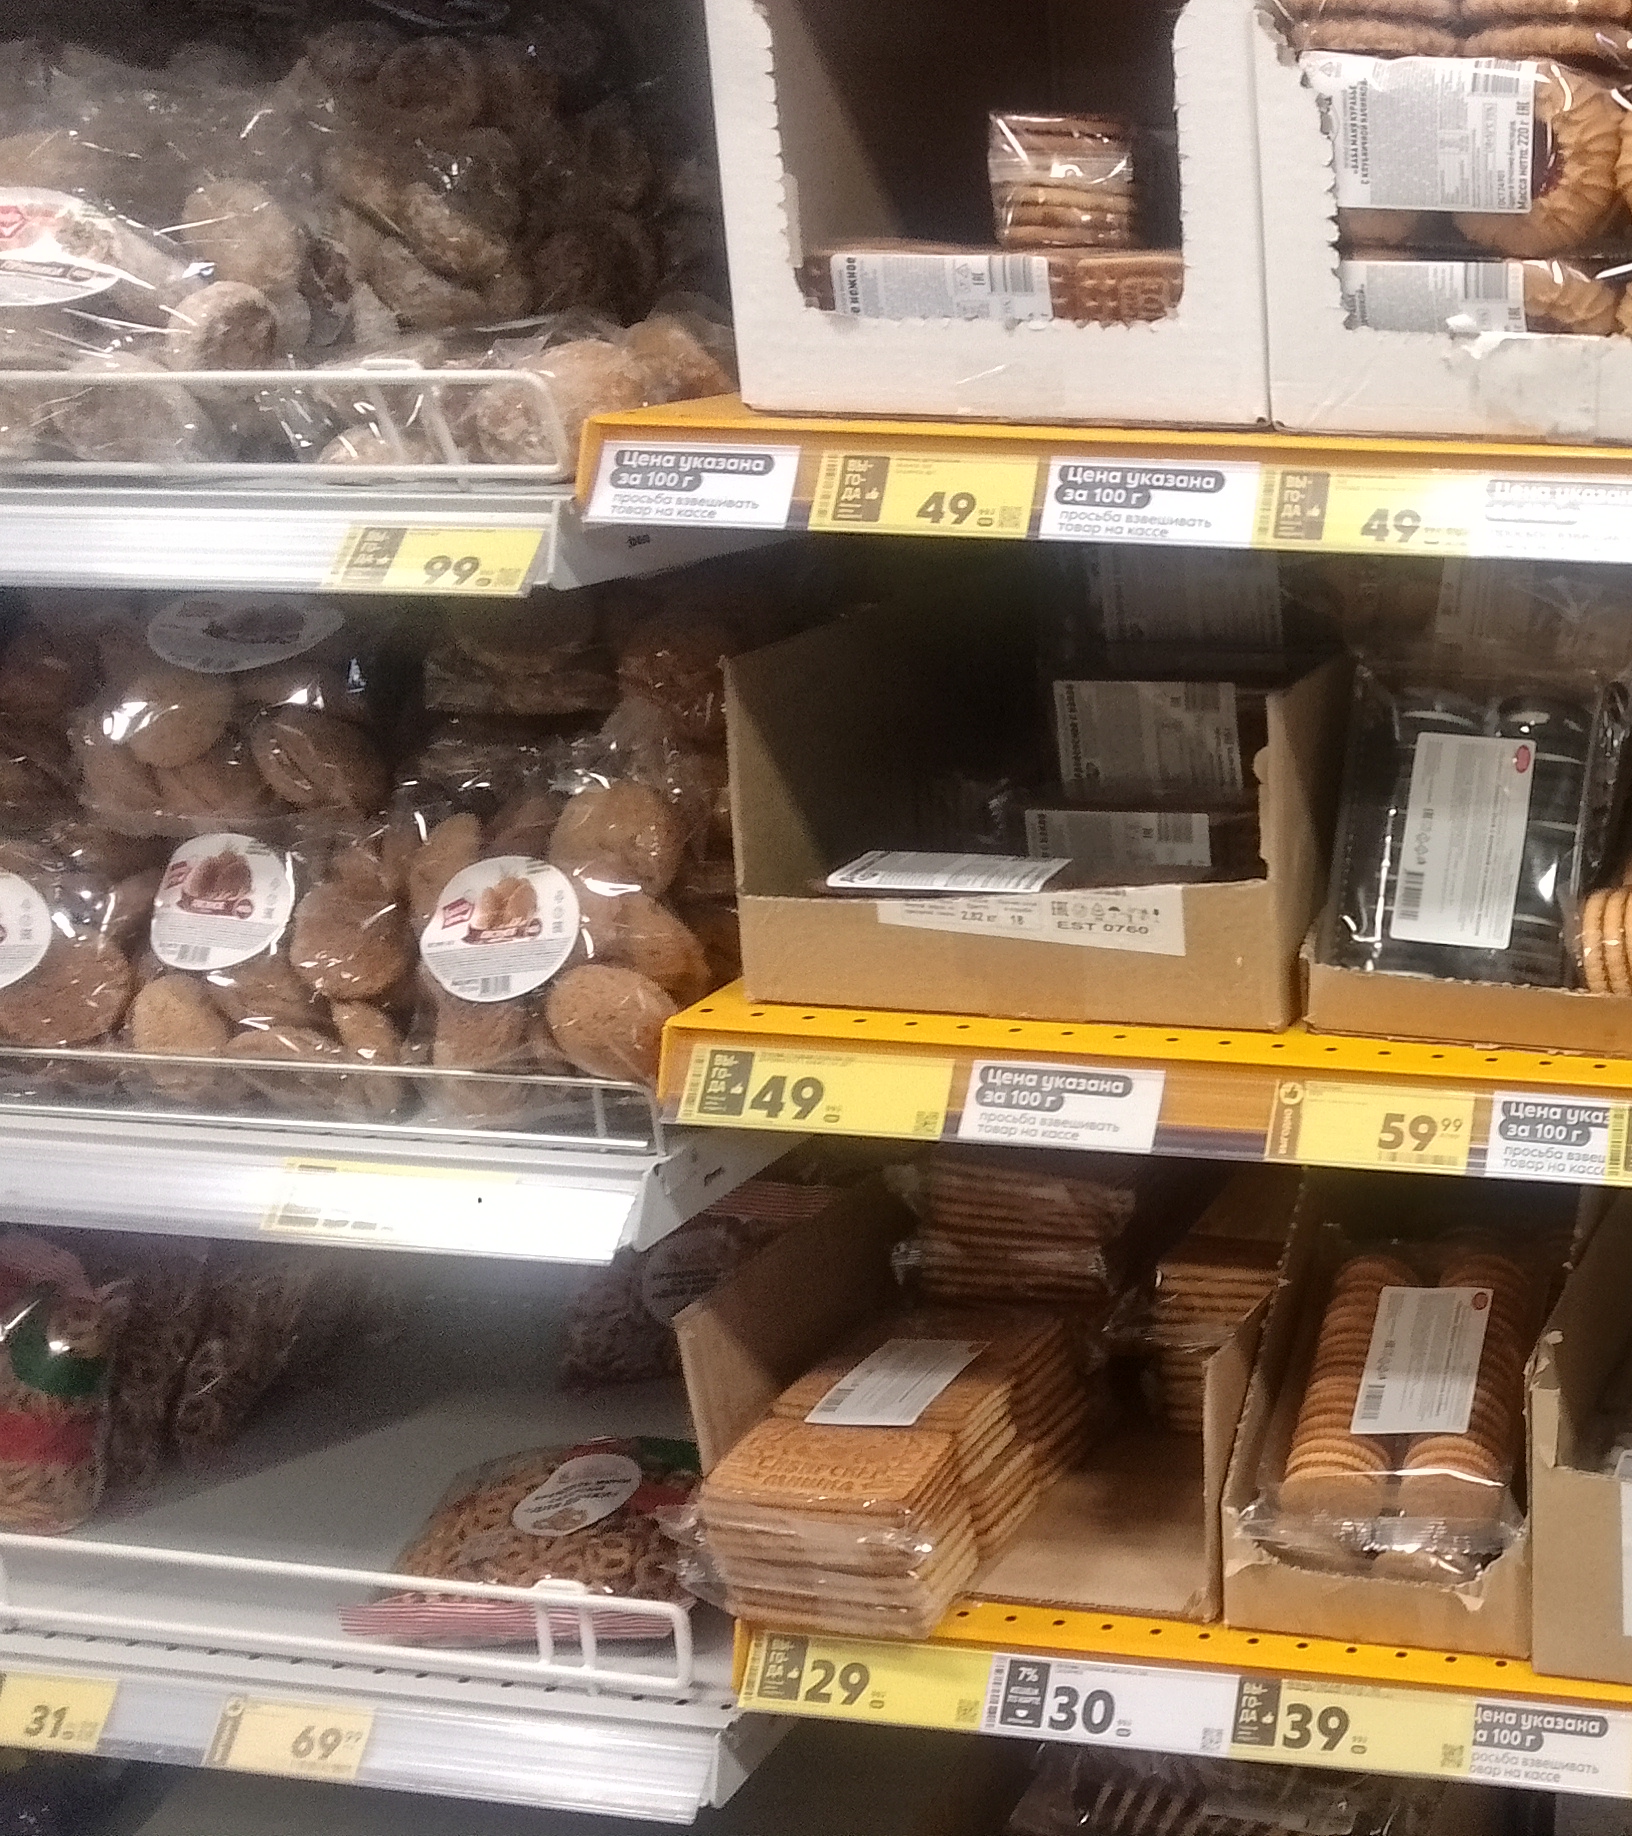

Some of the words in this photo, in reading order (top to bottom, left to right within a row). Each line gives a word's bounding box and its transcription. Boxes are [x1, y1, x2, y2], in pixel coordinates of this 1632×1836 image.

[1515, 127, 1529, 146] 220
[623, 451, 675, 468] Цена
[680, 456, 765, 471] указана
[617, 473, 641, 485] за
[647, 472, 679, 487] 100
[682, 476, 695, 488] г
[1067, 466, 1121, 483] Цена
[1126, 472, 1215, 489] указана
[1063, 488, 1088, 501] за
[1094, 488, 1127, 503] 100
[1131, 492, 1143, 504] г
[916, 491, 977, 524] 49
[1361, 508, 1421, 542] 49
[424, 555, 480, 585] 99
[1057, 920, 1097, 931] EST
[987, 1068, 1037, 1086] Цена
[1042, 1075, 1125, 1093] указана
[748, 1075, 824, 1120] 49
[983, 1090, 1006, 1103] за
[1011, 1090, 1041, 1106] 100
[1045, 1095, 1057, 1107] г
[1510, 1103, 1561, 1119] Цена
[1567, 1109, 1609, 1124] указ
[1377, 1113, 1438, 1151] 59
[1507, 1124, 1530, 1136] за
[1536, 1124, 1566, 1139] 100
[1571, 1130, 1582, 1142] г
[804, 1659, 870, 1705] 29
[1047, 1686, 1115, 1734] 30
[25, 1705, 70, 1738] 31
[1282, 1703, 1350, 1751] 39
[1521, 1714, 1600, 1734] указана
[291, 1726, 343, 1760] 69
[1492, 1729, 1521, 1745] 100
[1526, 1734, 1536, 1747] г
[1472, 1753, 1518, 1764] росьба
[1470, 1765, 1499, 1777] овар
